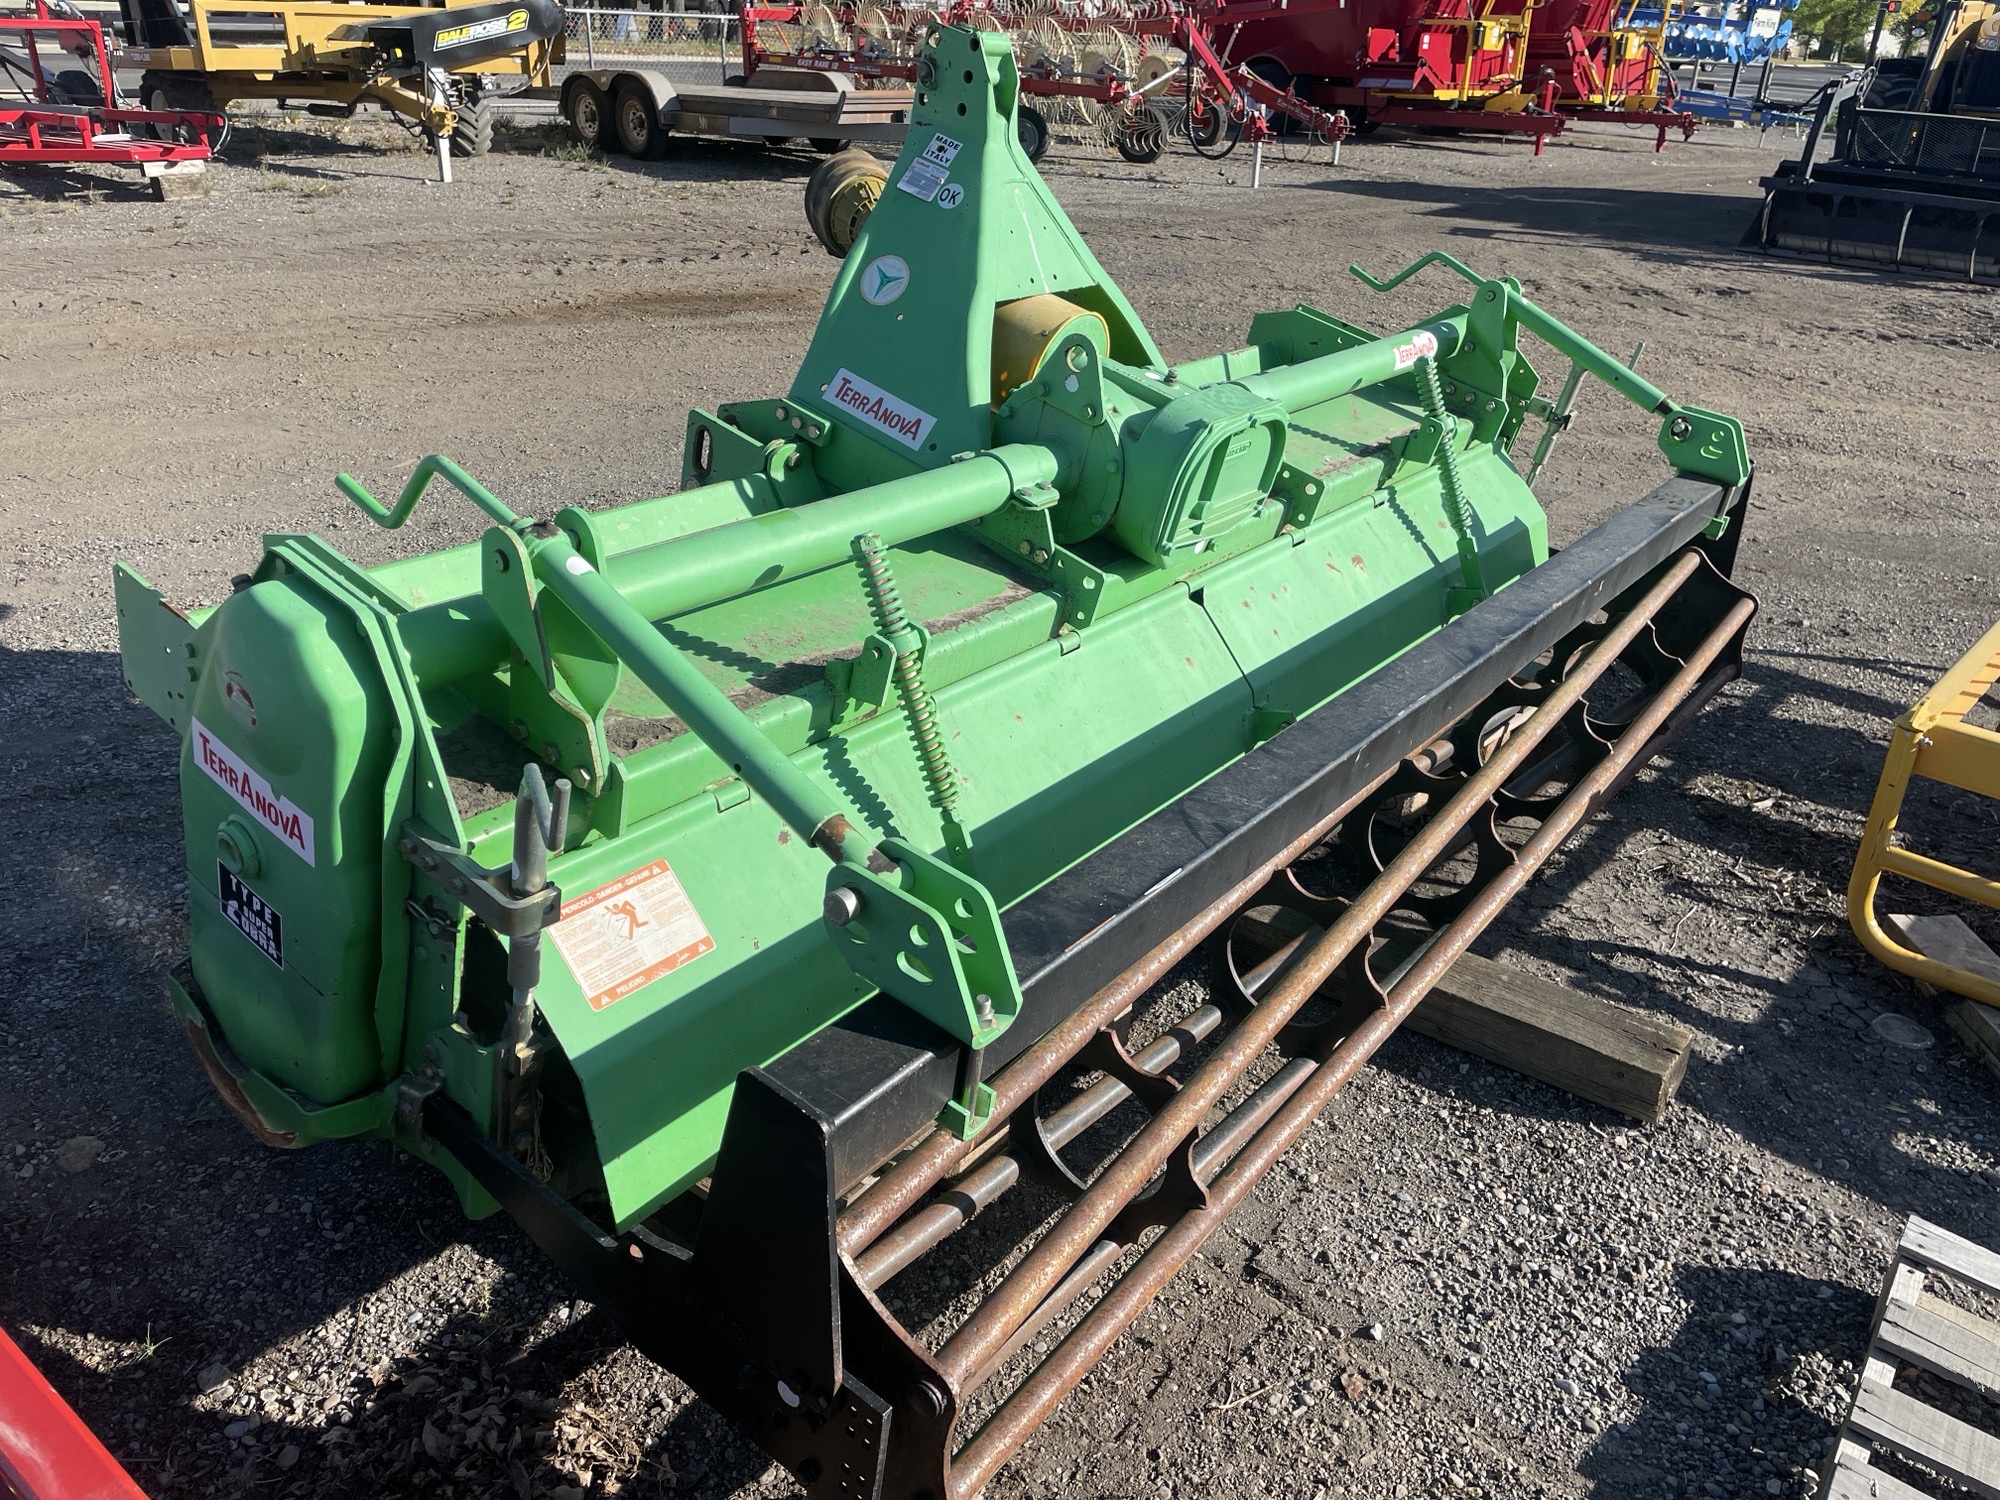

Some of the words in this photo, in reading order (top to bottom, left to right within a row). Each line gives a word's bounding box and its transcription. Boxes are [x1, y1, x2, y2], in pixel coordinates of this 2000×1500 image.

[507, 11, 528, 32] 2
[797, 58, 814, 67] EASY
[813, 60, 830, 69] RAKE
[925, 149, 952, 164] ITALY
[935, 135, 961, 151] MADE
[939, 187, 961, 205] OK
[834, 376, 923, 441] TERRANOVA
[198, 731, 306, 850] TERRANOVA
[229, 873, 273, 926] TYPE
[562, 896, 595, 917] PERICOLO
[596, 882, 624, 900] DANGER
[625, 870, 651, 886] GEFAHR
[227, 900, 278, 959] COBRA
[243, 905, 275, 940] SUPER
[616, 975, 646, 995] PELIGRO
